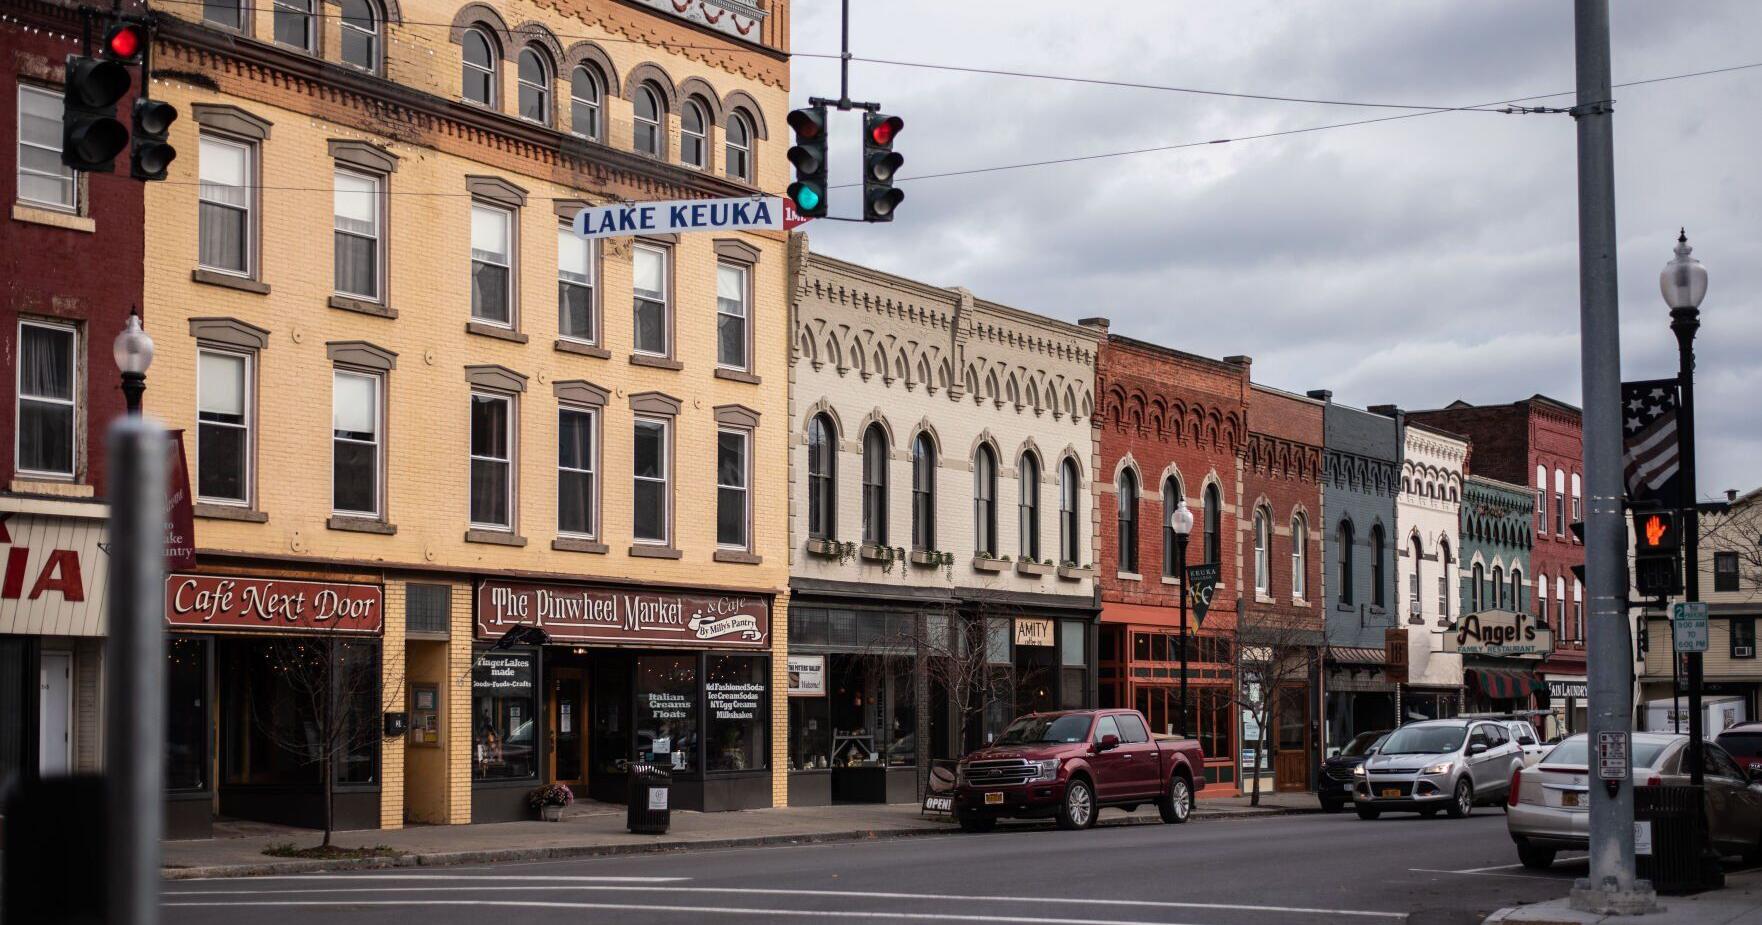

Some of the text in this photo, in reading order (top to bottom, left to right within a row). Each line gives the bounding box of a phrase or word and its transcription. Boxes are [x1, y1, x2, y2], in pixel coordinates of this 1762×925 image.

[583, 206, 656, 235] LAKE
[670, 201, 773, 228] KEUKA
[174, 579, 375, 621] Café Next Door
[708, 600, 717, 613] &
[492, 587, 684, 631] The Pinwheel Market
[1676, 606, 1683, 619] 2
[700, 619, 754, 637] By Milly's Pantry
[1017, 619, 1049, 643] AMITY
[1457, 614, 1536, 647] Angel's
[491, 668, 515, 676] made
[648, 693, 685, 701] Italian
[716, 711, 753, 719] Milkshakes
[926, 797, 952, 810] OPEN!
